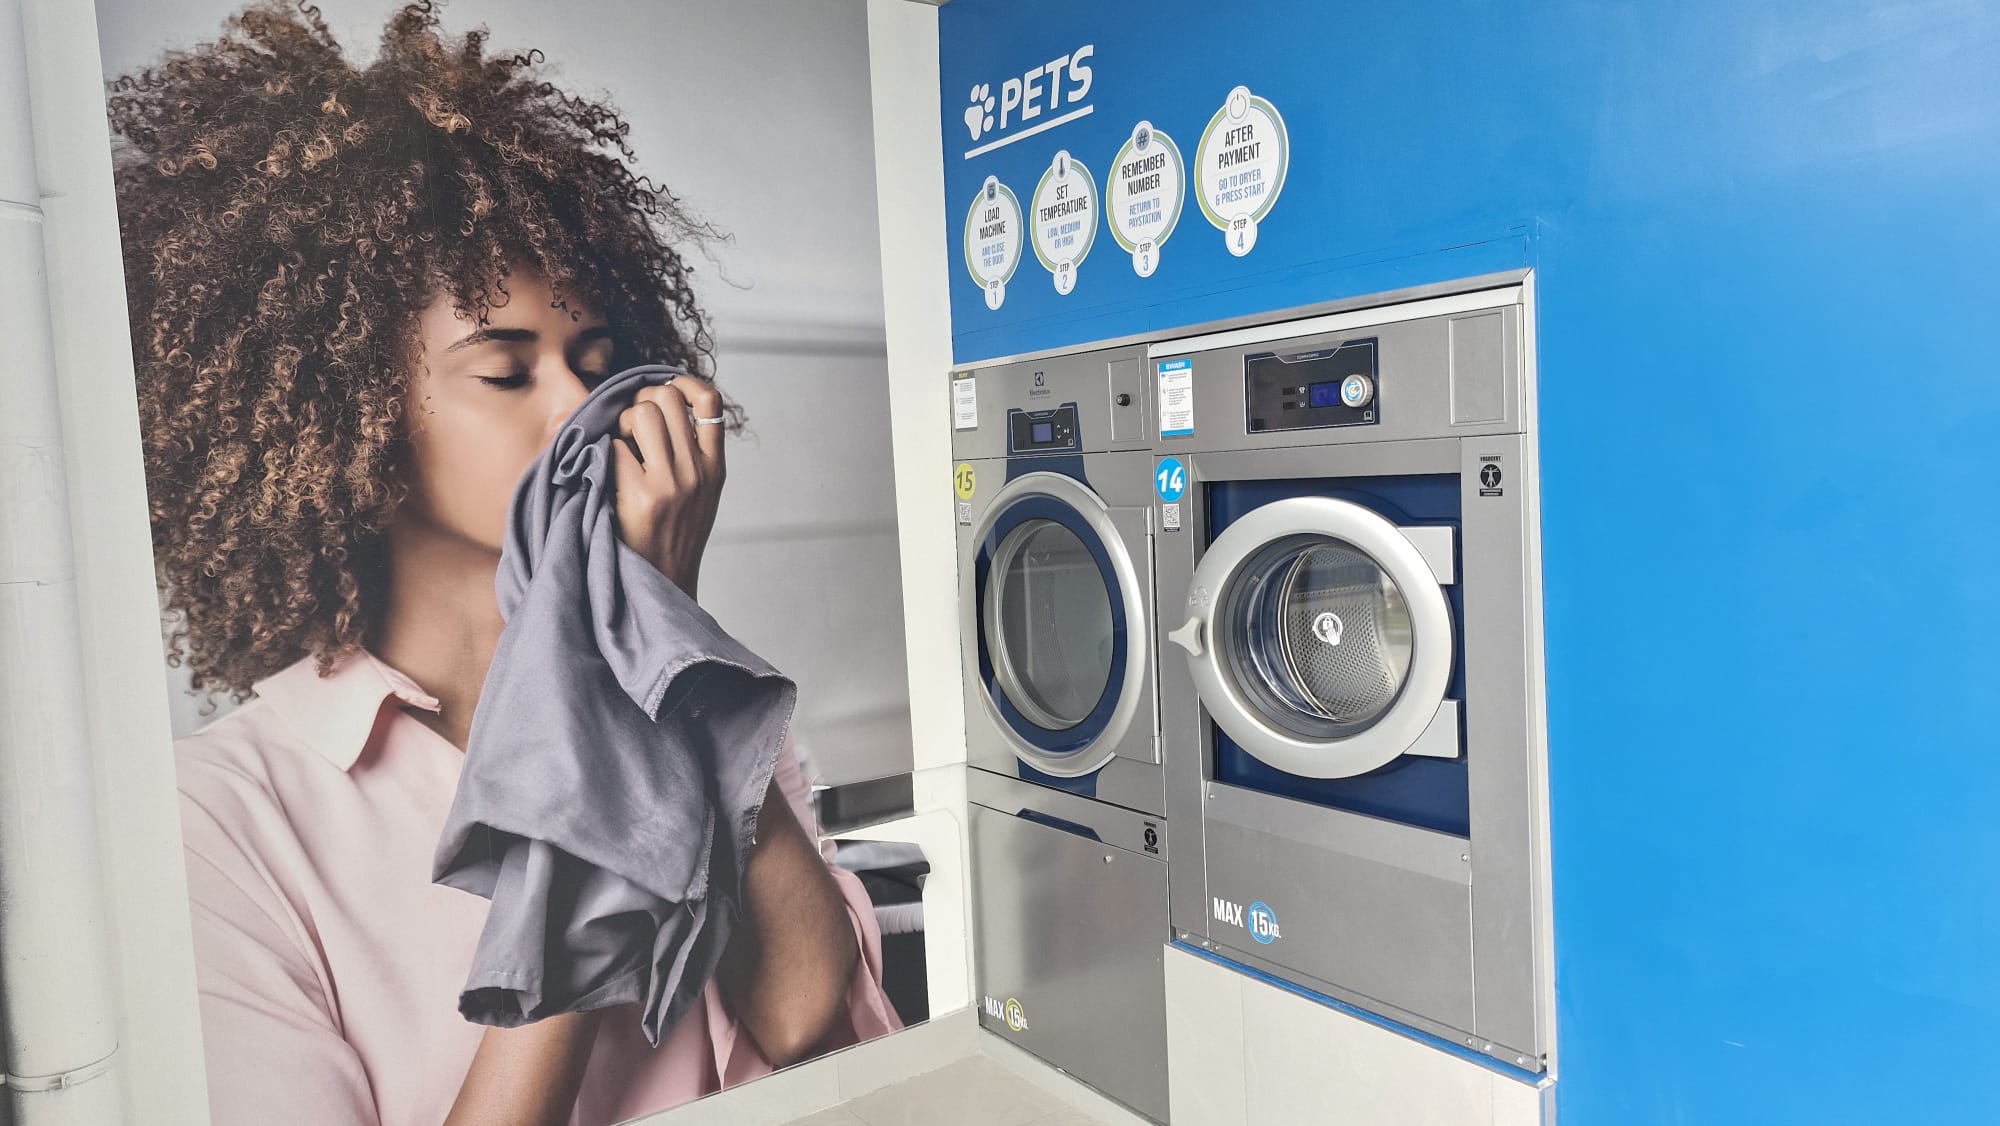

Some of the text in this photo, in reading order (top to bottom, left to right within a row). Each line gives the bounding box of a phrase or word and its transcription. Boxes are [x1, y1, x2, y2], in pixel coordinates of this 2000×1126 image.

[1000, 44, 1094, 129] PETS
[1224, 124, 1254, 148] AFTER
[1218, 142, 1261, 169] PAYMENT
[1121, 153, 1166, 180] REMEMBER
[1127, 173, 1161, 196] NUMBER
[1218, 168, 1262, 191] GO TO DRYER
[1056, 184, 1068, 200] SET
[1221, 188, 1243, 204] PRESS
[1244, 182, 1265, 199] START
[984, 206, 1000, 222] LOAD
[1039, 196, 1088, 222] TEMPERATURE
[1129, 197, 1160, 216] RETURN TO
[1060, 220, 1081, 234] MEDIUM
[1128, 211, 1162, 229] PAYSTATION
[1233, 218, 1247, 231] STEP
[979, 221, 1006, 240] MACHINE
[982, 242, 1005, 256] AND CLOSE
[1054, 238, 1062, 249] OR
[1139, 242, 1152, 253] STEP
[1237, 231, 1244, 249] 4
[983, 257, 992, 268] THE
[1059, 263, 1070, 273] STEP
[1143, 254, 1149, 271] 3
[989, 280, 999, 289] STEP
[1062, 274, 1068, 289] 2
[993, 291, 997, 305] 1
[956, 470, 973, 491] 15
[1158, 466, 1183, 493] 14
[1213, 895, 1244, 928] MAX
[984, 995, 1005, 1021] MAX
